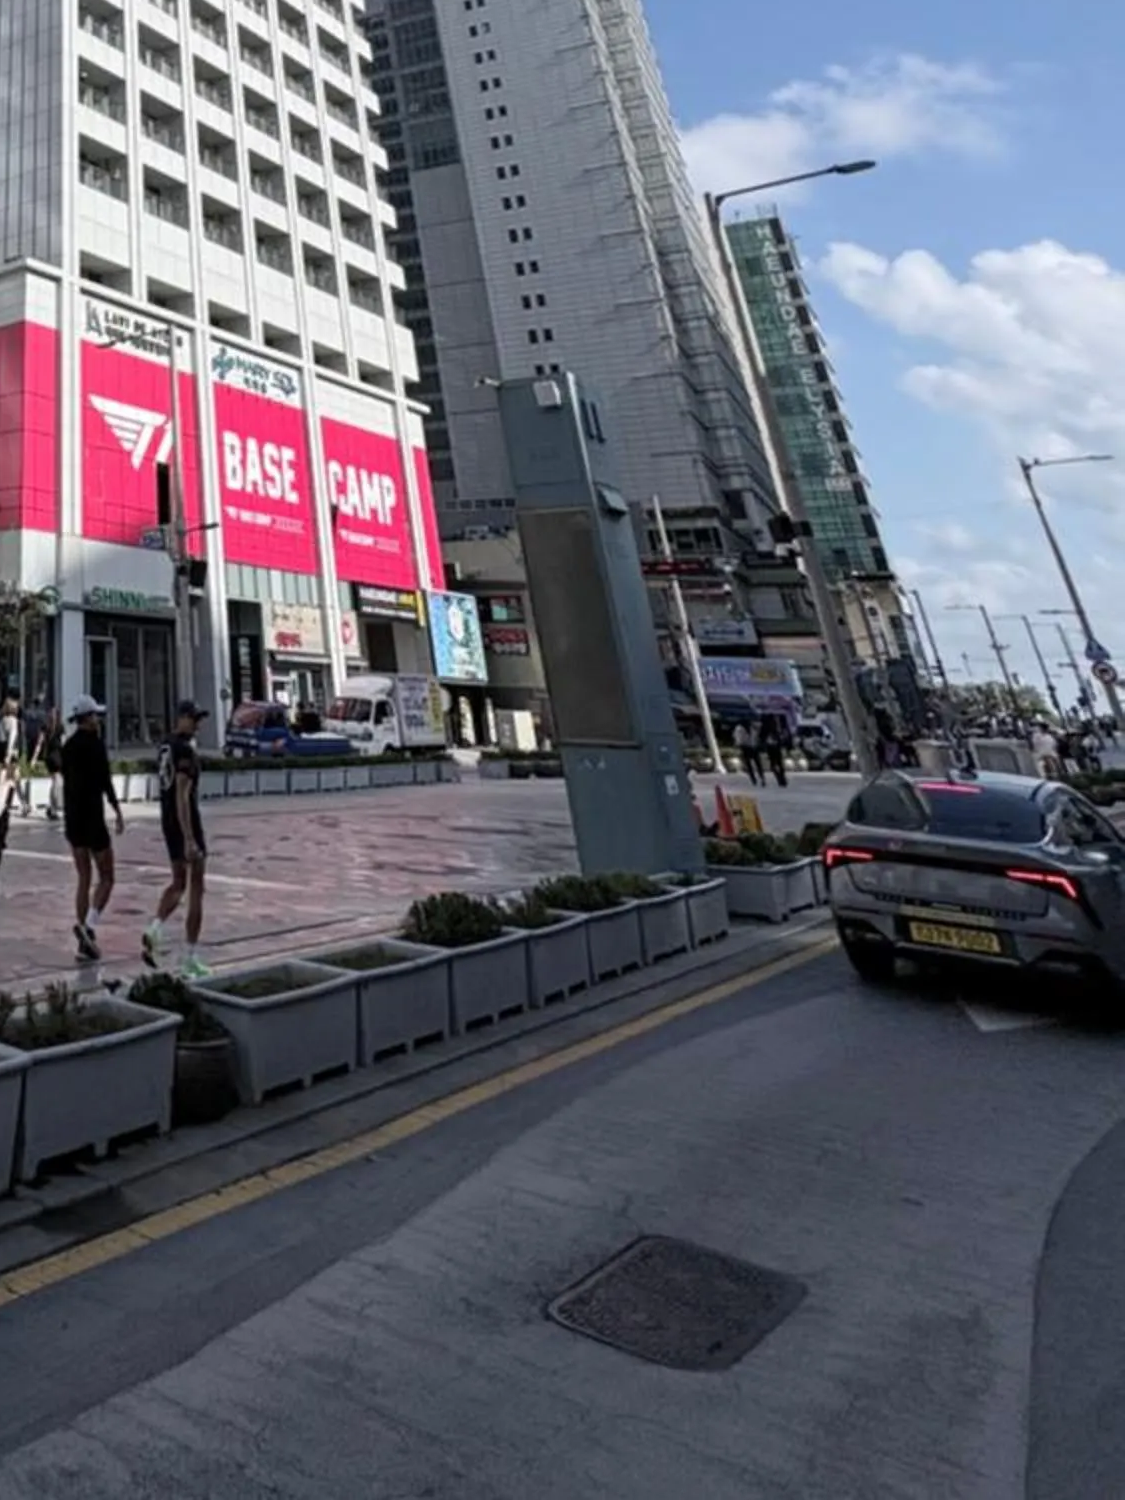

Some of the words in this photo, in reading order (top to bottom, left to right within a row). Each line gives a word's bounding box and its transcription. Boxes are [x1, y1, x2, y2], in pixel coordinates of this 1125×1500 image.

[756, 226, 807, 355] HAEUNDAE
[222, 430, 300, 505] BASE
[327, 459, 397, 527] CAMP
